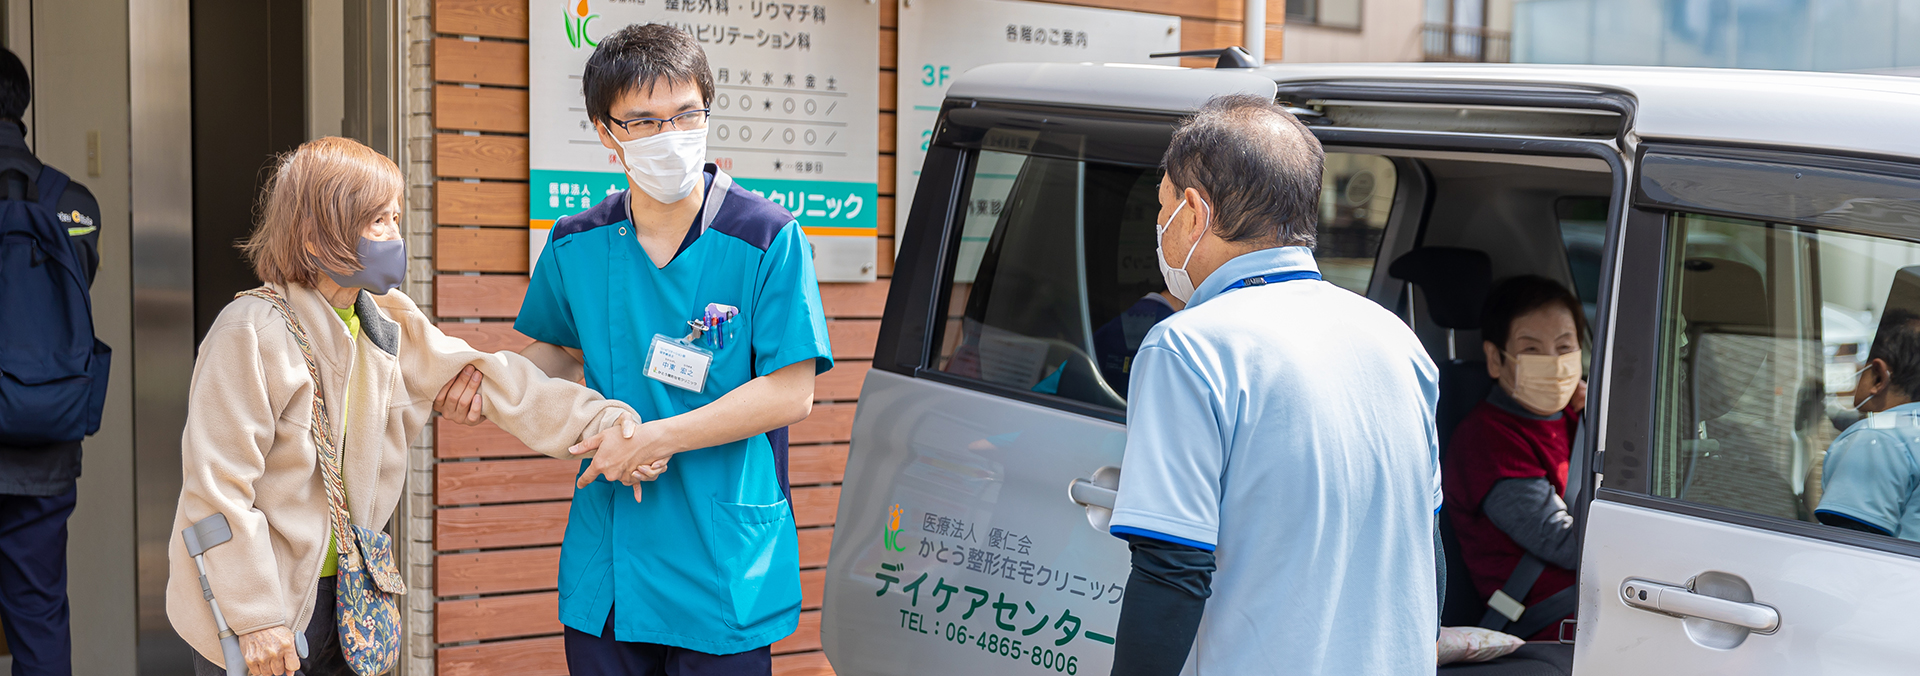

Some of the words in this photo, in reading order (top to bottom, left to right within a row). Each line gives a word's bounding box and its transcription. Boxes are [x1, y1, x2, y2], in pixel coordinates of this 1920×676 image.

[1006, 24, 1088, 49] 各階のご案内
[718, 68, 730, 83] 月
[740, 69, 752, 85] 火
[783, 73, 796, 87] 木
[804, 73, 817, 89] 金
[826, 76, 838, 91] 土
[922, 64, 950, 87] 3F
[751, 189, 863, 219] クリニック
[922, 512, 977, 543] 医療法人
[988, 527, 1033, 556] 優仁会
[918, 537, 1124, 605] かとう整形在宅クリニック
[875, 562, 1116, 647] デイケアセンター
